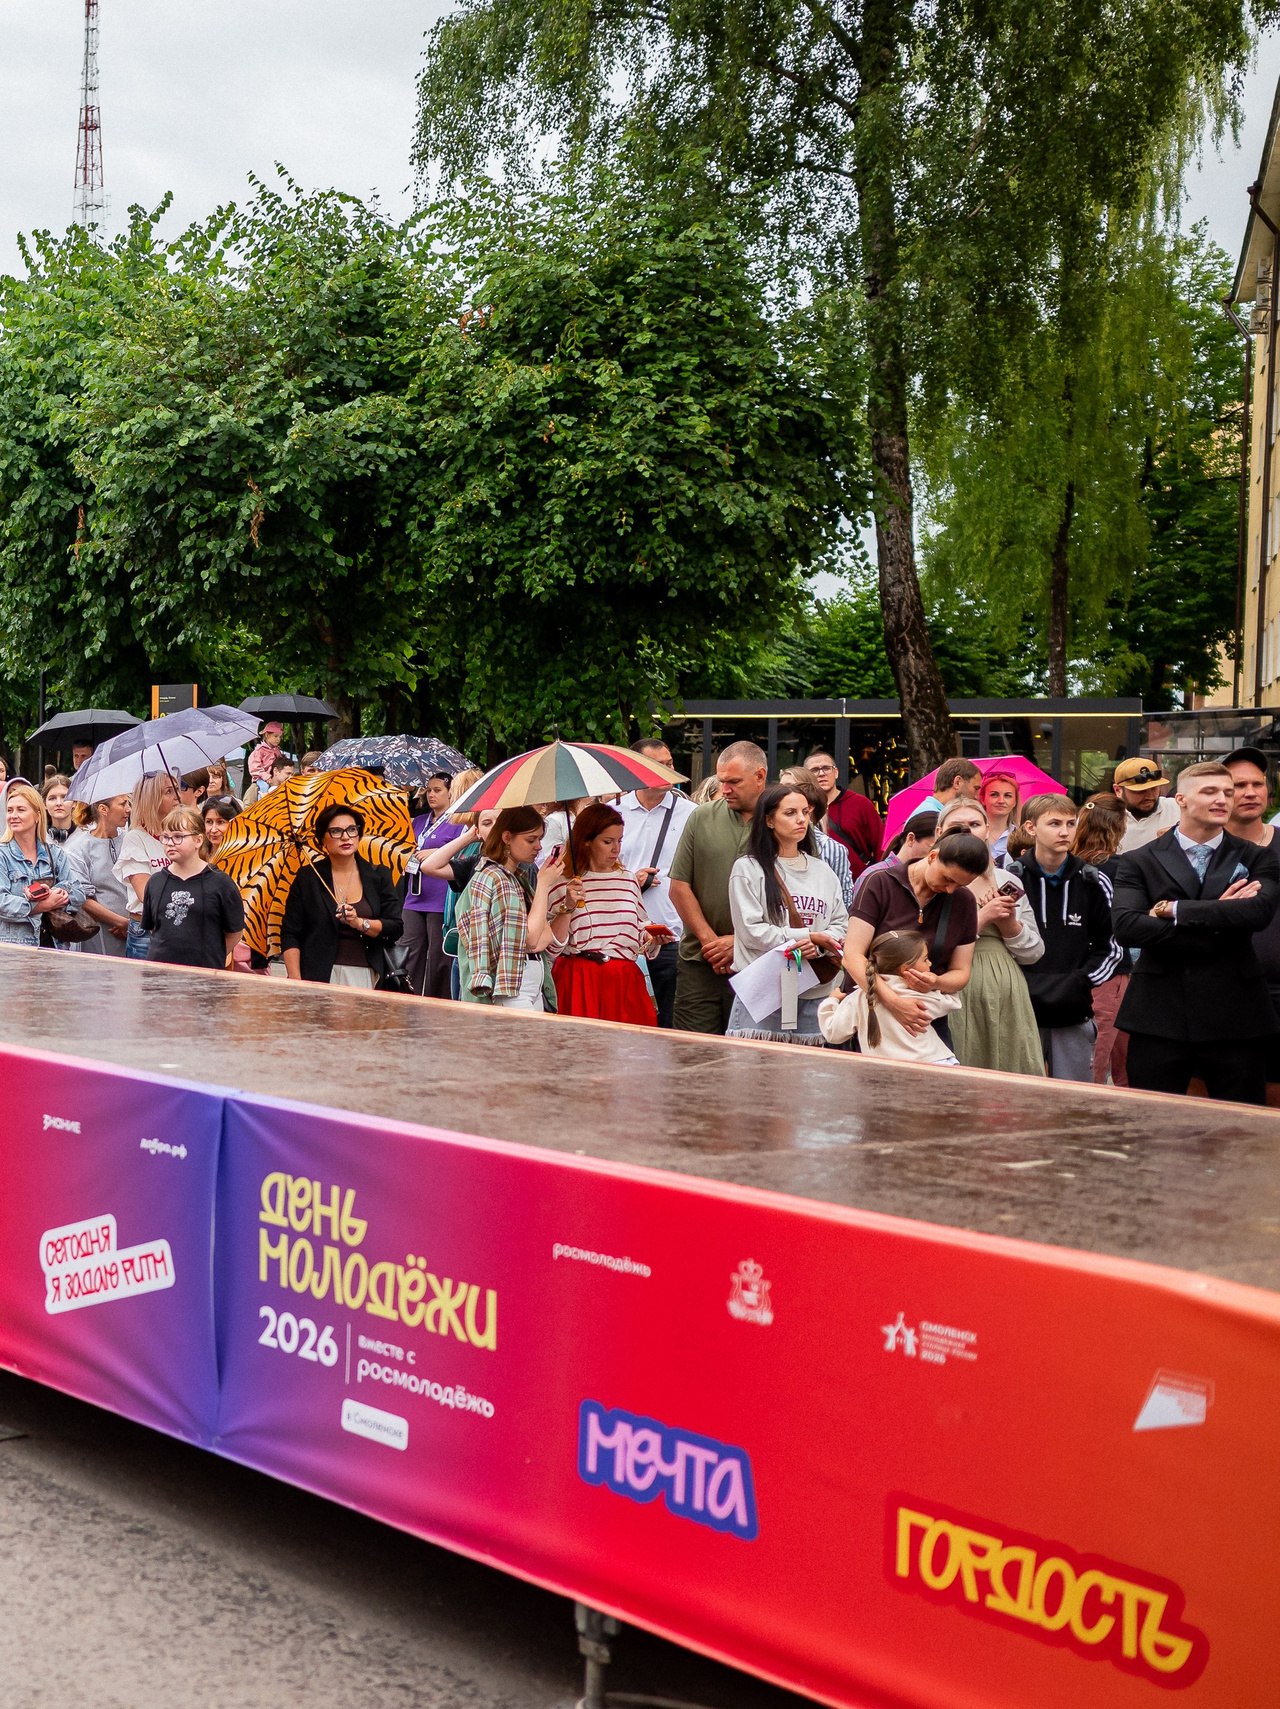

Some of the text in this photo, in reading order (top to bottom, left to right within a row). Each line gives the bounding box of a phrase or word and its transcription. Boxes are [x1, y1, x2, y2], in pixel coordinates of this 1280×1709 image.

[552, 1242, 652, 1278] росмолодёжь
[258, 1305, 339, 1368] 2026
[357, 1333, 417, 1366] вместе с
[356, 1357, 496, 1419] росмолодёжь
